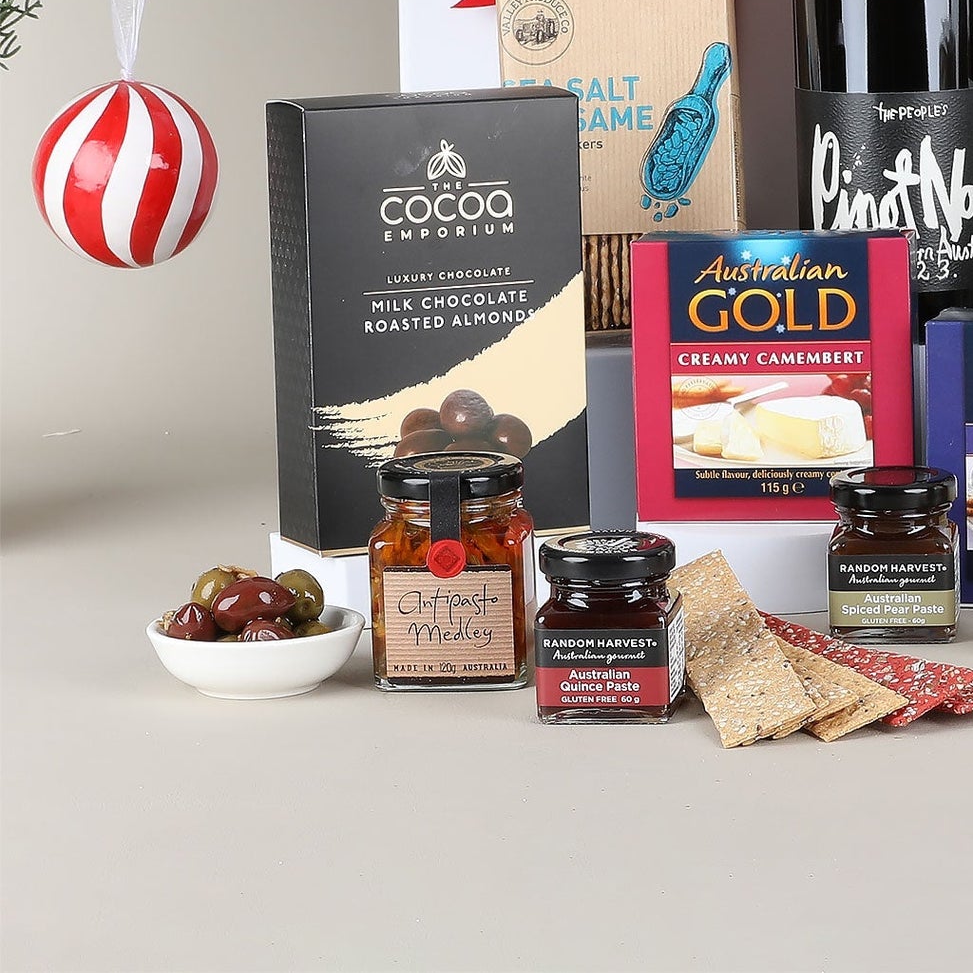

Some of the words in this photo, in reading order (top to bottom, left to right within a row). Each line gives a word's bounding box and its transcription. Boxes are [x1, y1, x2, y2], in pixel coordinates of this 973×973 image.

[566, 75, 640, 102] SALT
[579, 106, 654, 132] SAME
[898, 103, 948, 121] PEOPLE'S
[432, 181, 463, 191] THE
[811, 123, 920, 240] Pinot
[384, 223, 514, 242] EMPORIUM
[387, 272, 433, 284] LUXURY
[439, 267, 511, 280] CHOCOLATE
[694, 253, 848, 284] Australian
[371, 298, 414, 313] MILK
[421, 289, 528, 310] CHOCOLATE
[688, 288, 857, 332] GOLD
[364, 315, 445, 334] ROASTED
[678, 352, 750, 366] CREAMY
[757, 351, 864, 365] CAMEMBERT
[695, 469, 720, 479] Subtle
[722, 469, 750, 481] flavour,
[752, 469, 794, 481] deliciously
[796, 470, 825, 481] creamy
[761, 482, 780, 493] 115
[839, 564, 888, 573] RANDOM
[848, 574, 898, 585] Australian
[899, 575, 936, 587] gourmet
[398, 584, 499, 625] Antipasto
[864, 594, 921, 603] Australian
[841, 605, 881, 615] Spiced
[884, 605, 910, 614] Pear
[912, 604, 945, 614] Paste
[408, 619, 493, 648] Medley
[543, 638, 595, 649] RANDOM
[552, 649, 605, 662] Australian
[606, 650, 646, 665] gourmet
[423, 664, 434, 672] IN
[463, 662, 507, 672] AUSTRALIA
[569, 668, 631, 680] Australian
[560, 681, 603, 693] Quince
[606, 680, 640, 692] Paste
[561, 695, 594, 703] GLUTEN
[596, 695, 617, 703] FREE
